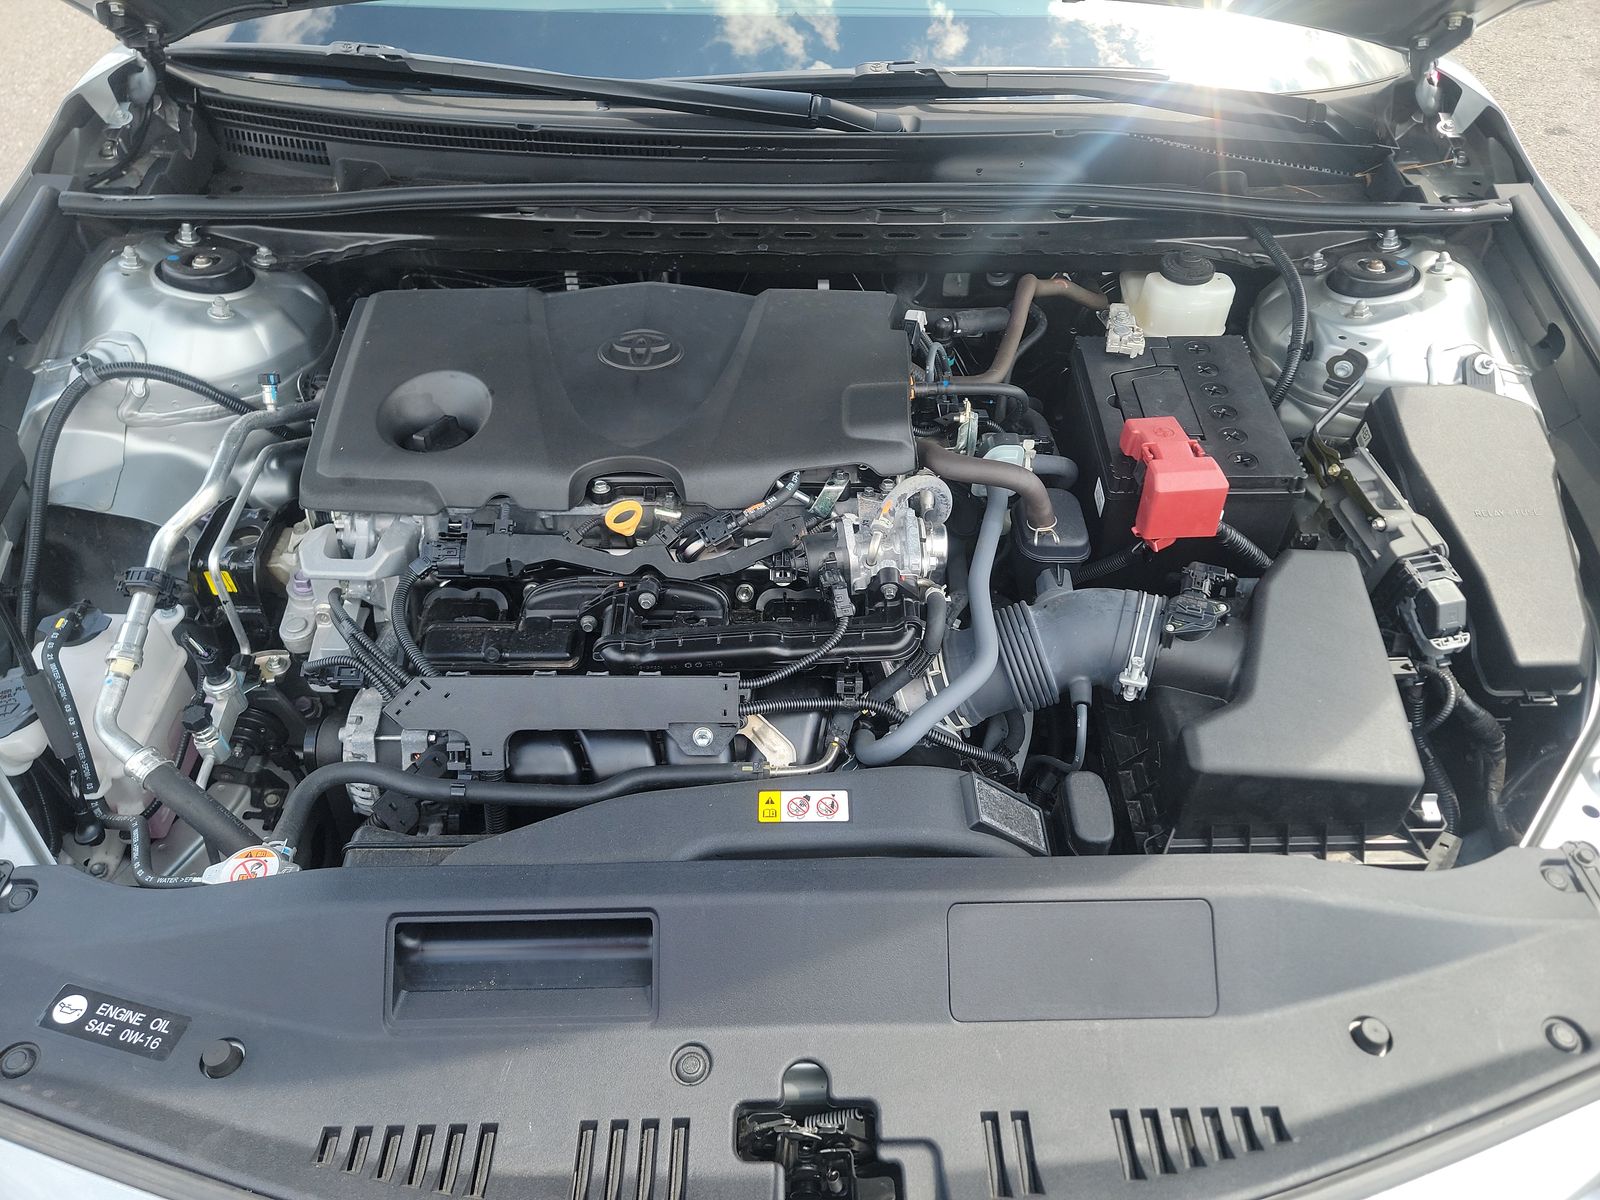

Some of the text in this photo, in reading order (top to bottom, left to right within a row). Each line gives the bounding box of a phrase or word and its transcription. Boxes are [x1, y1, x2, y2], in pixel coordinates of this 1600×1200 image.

[156, 876, 179, 884] WATER
[96, 1003, 171, 1034] ENGINE OIL
[85, 1019, 162, 1049] SAE 0W-16
